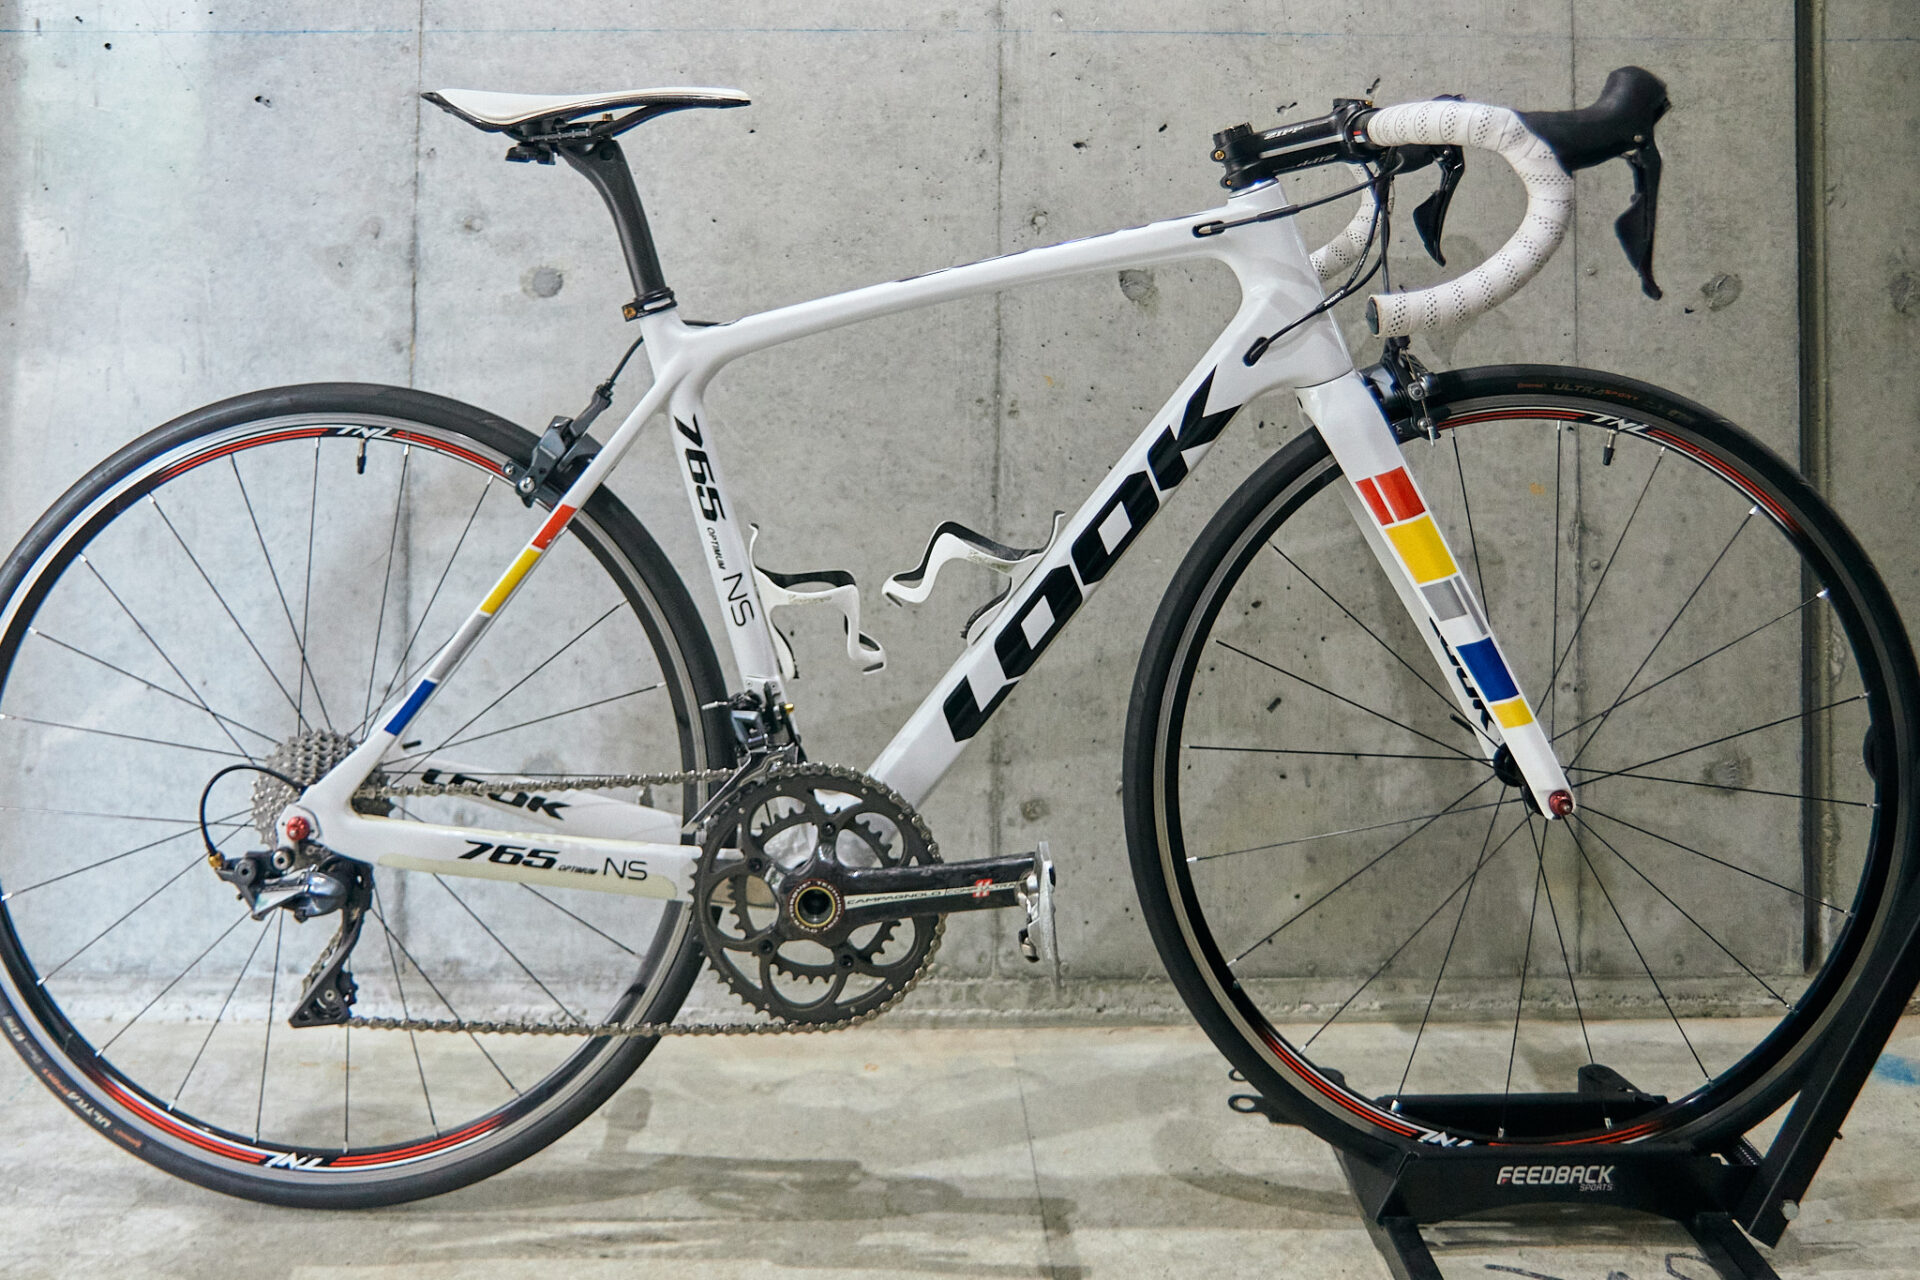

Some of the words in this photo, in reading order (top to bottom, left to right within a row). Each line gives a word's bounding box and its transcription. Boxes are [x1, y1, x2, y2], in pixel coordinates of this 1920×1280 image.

[1592, 414, 1649, 431] TNL
[336, 425, 393, 439] TNL
[674, 413, 726, 522] 765
[723, 572, 755, 627] NS
[943, 365, 1242, 742] LOOK
[458, 840, 561, 870] 765
[603, 857, 648, 881] NS
[846, 890, 941, 905] CAMPAGNOLO
[1497, 1165, 1615, 1185] FEEDBACK
[1579, 1183, 1613, 1192] SPORTS
